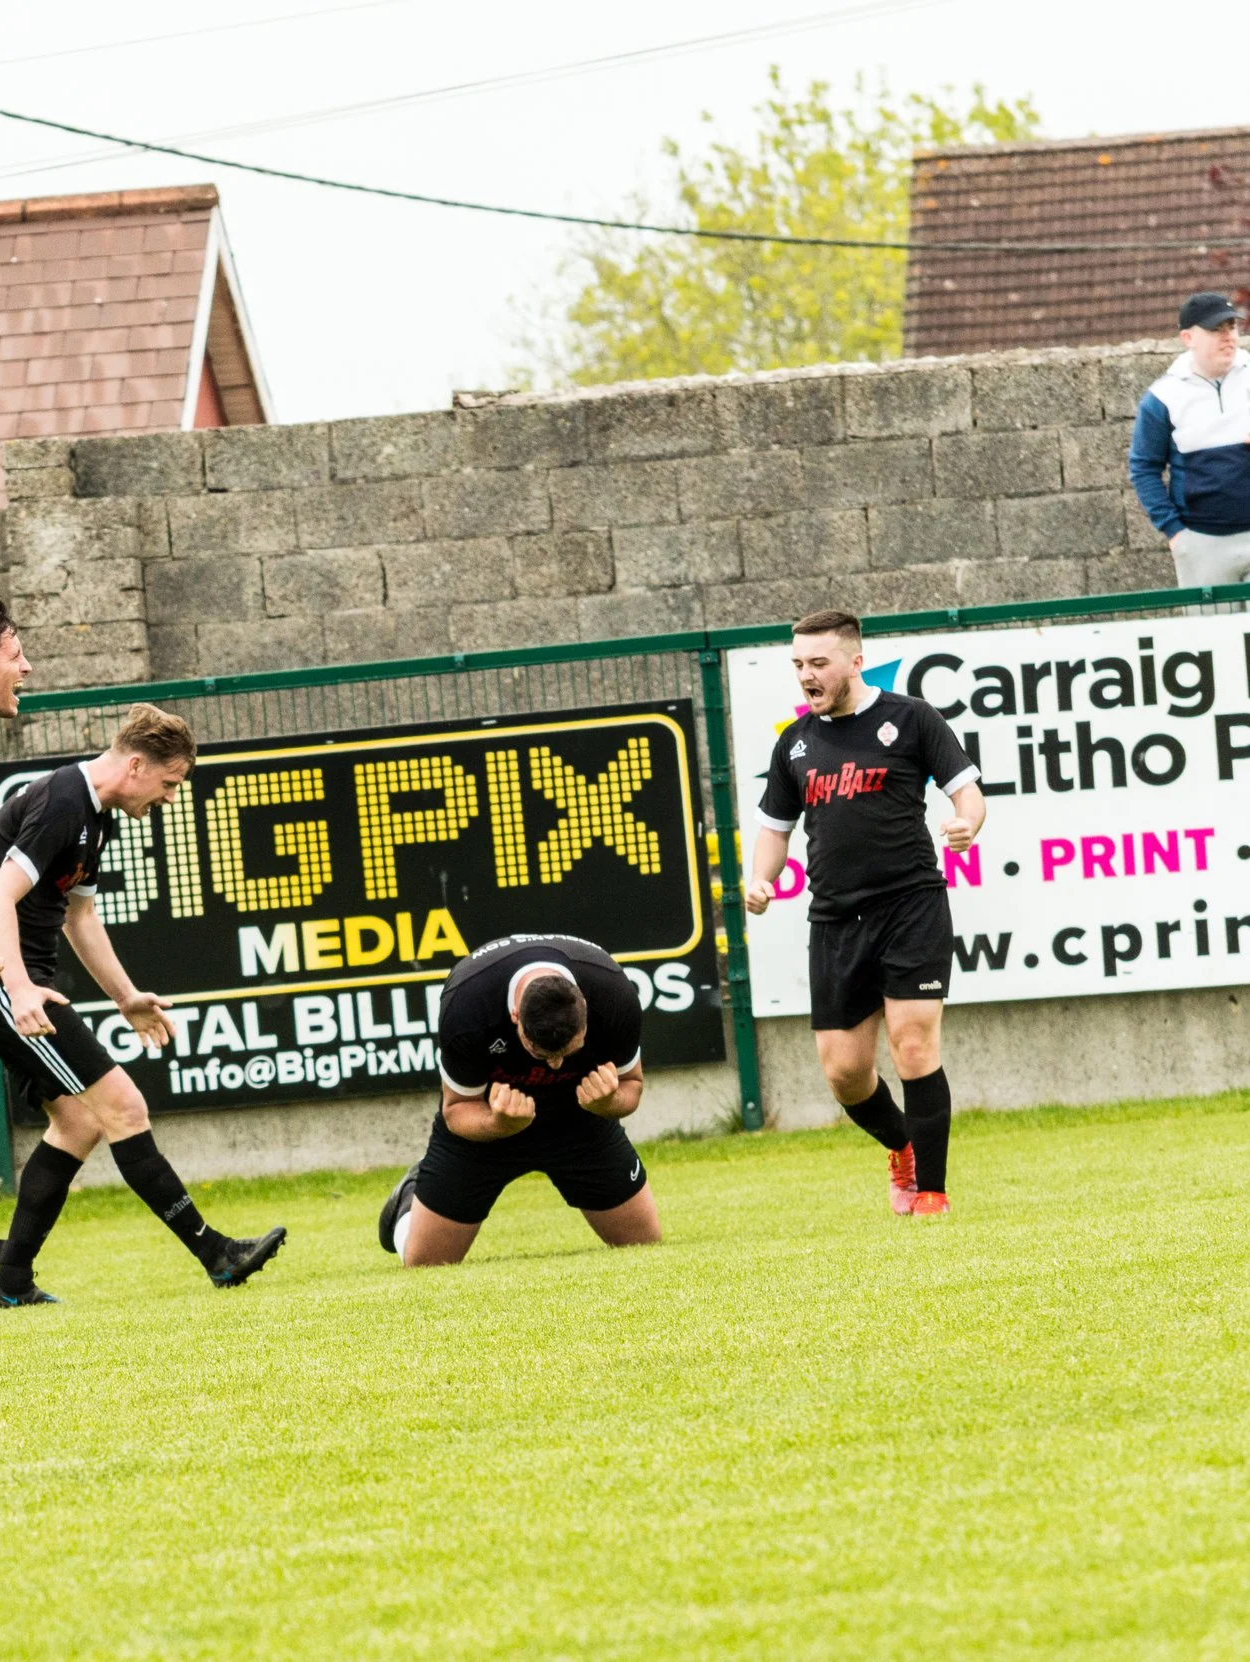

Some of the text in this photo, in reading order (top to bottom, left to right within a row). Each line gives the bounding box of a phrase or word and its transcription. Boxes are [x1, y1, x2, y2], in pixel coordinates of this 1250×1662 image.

[907, 636, 1216, 720] Carraig
[963, 720, 1187, 798] Litho
[1040, 827, 1216, 882] PRINT
[237, 907, 470, 977] MEDIA
[168, 1037, 441, 1095] info@BigPixM
